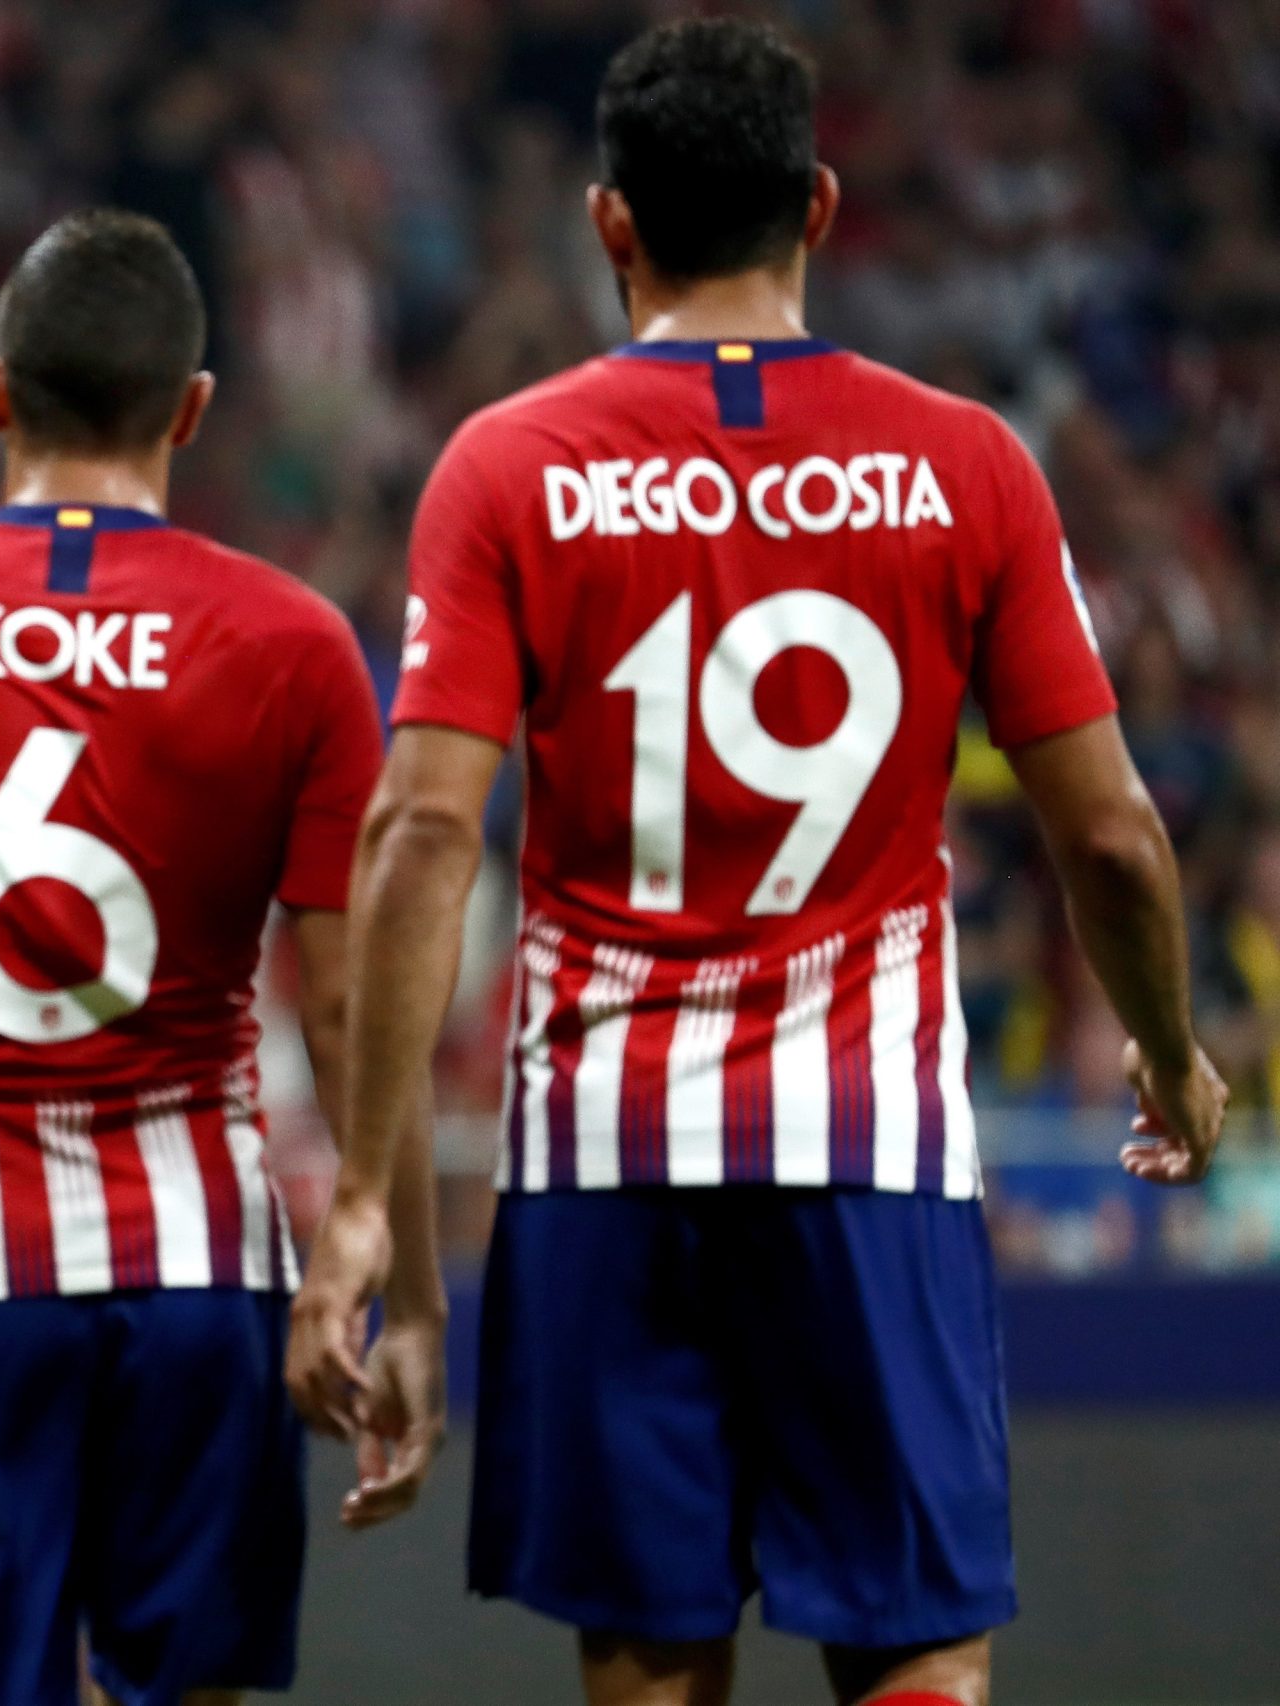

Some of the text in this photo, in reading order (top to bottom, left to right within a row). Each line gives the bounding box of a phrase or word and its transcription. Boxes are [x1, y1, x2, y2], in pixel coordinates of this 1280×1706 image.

[543, 452, 954, 541] DIEGO COSTA
[603, 588, 903, 917] 19
